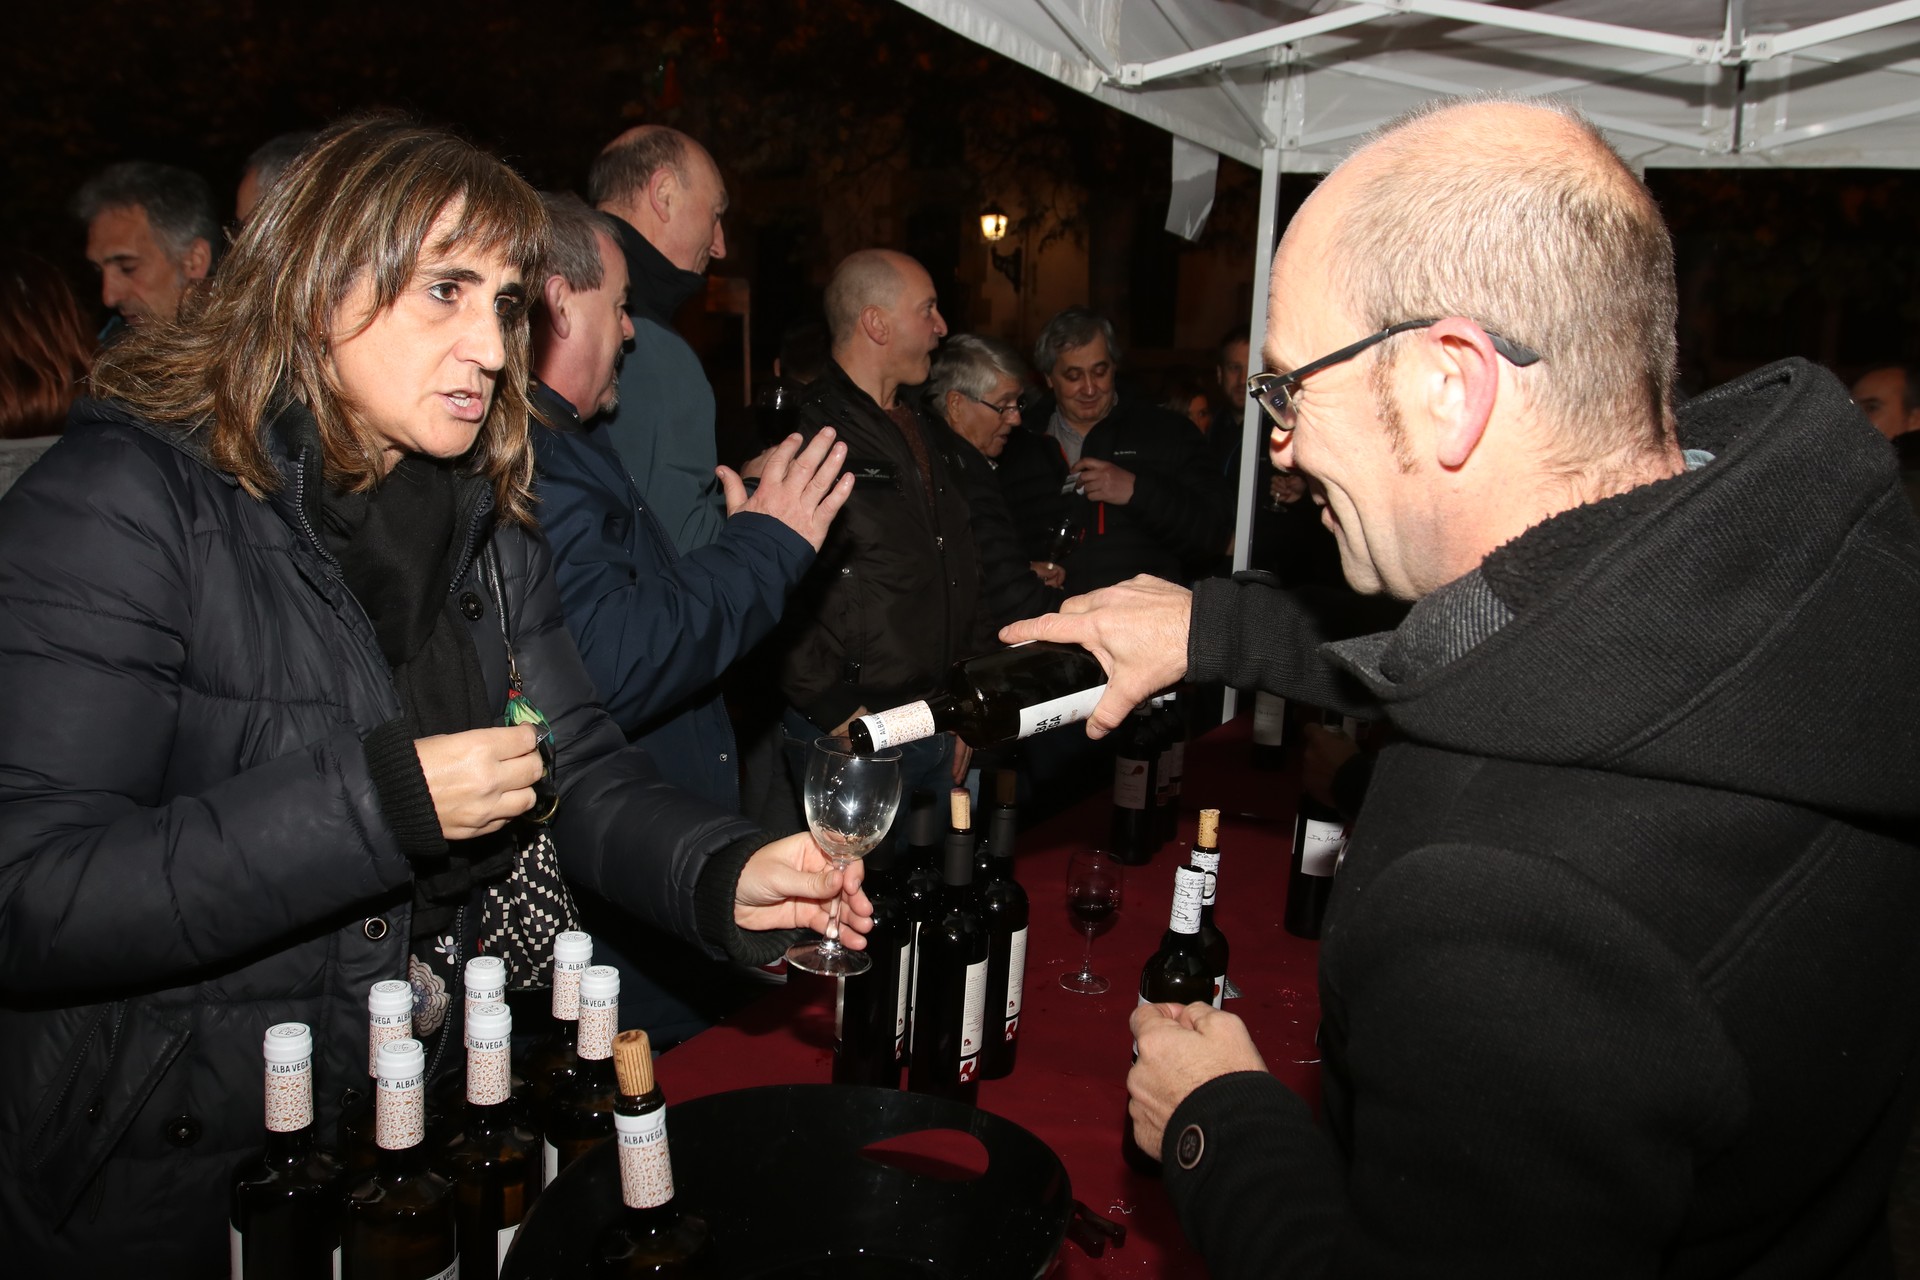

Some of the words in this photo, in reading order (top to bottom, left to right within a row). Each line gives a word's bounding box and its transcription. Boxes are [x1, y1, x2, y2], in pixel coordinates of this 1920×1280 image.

[876, 720, 886, 735] ALBA
[1034, 719, 1048, 733] BA
[1048, 714, 1062, 729] GA
[568, 963, 584, 971] ALBA
[487, 990, 502, 999] ALBA
[589, 1000, 607, 1008] VEGA
[374, 1015, 391, 1025] VEGA
[397, 1012, 410, 1023] ALBA
[470, 1038, 485, 1049] ALBA
[485, 1040, 504, 1049] VEGA
[271, 1064, 291, 1074] ALBA
[291, 1059, 309, 1072] VEGA
[395, 1079, 415, 1089] ALBA
[624, 1135, 645, 1145] ALBA
[645, 1128, 664, 1143] VEGA
